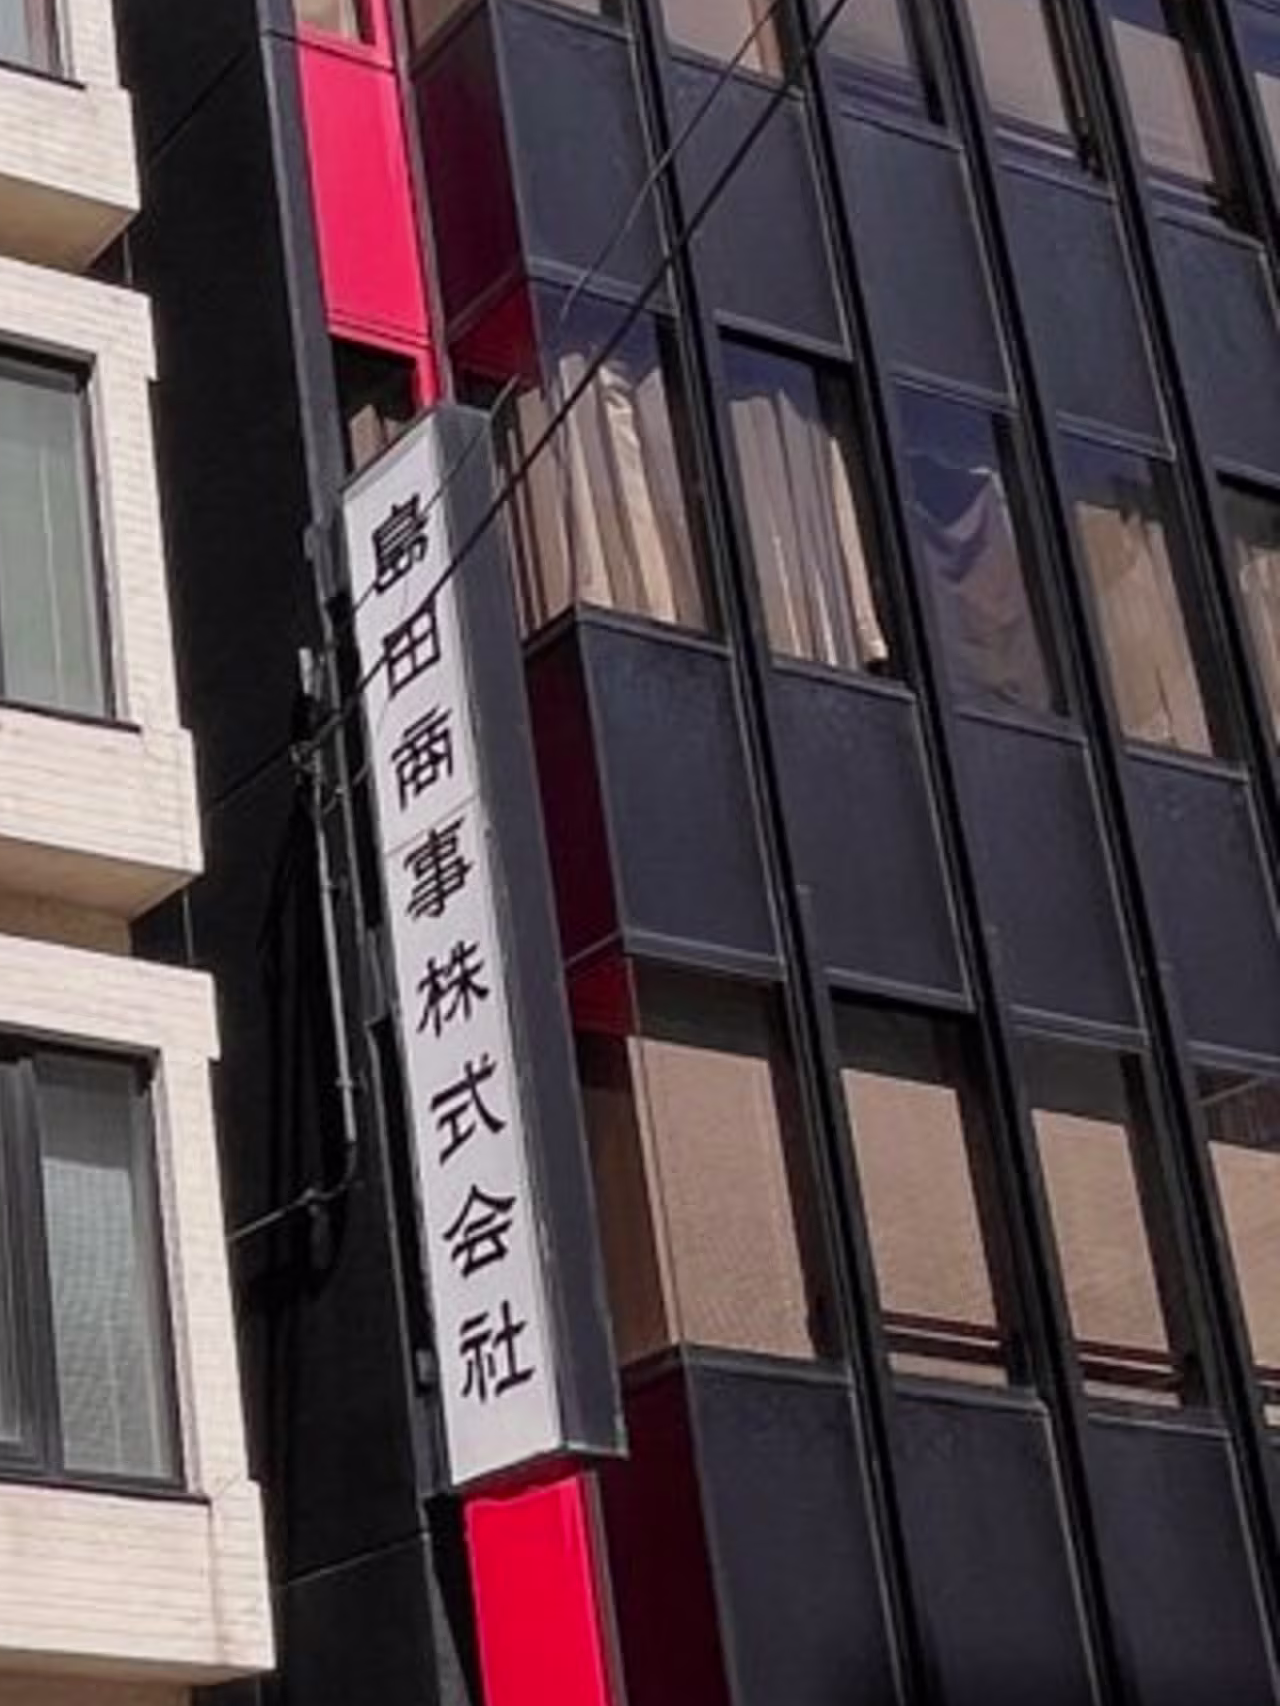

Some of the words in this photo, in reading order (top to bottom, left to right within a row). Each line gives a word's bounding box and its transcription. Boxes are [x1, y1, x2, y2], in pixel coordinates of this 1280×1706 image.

[371, 492, 536, 1404] 島田商事株式会社
